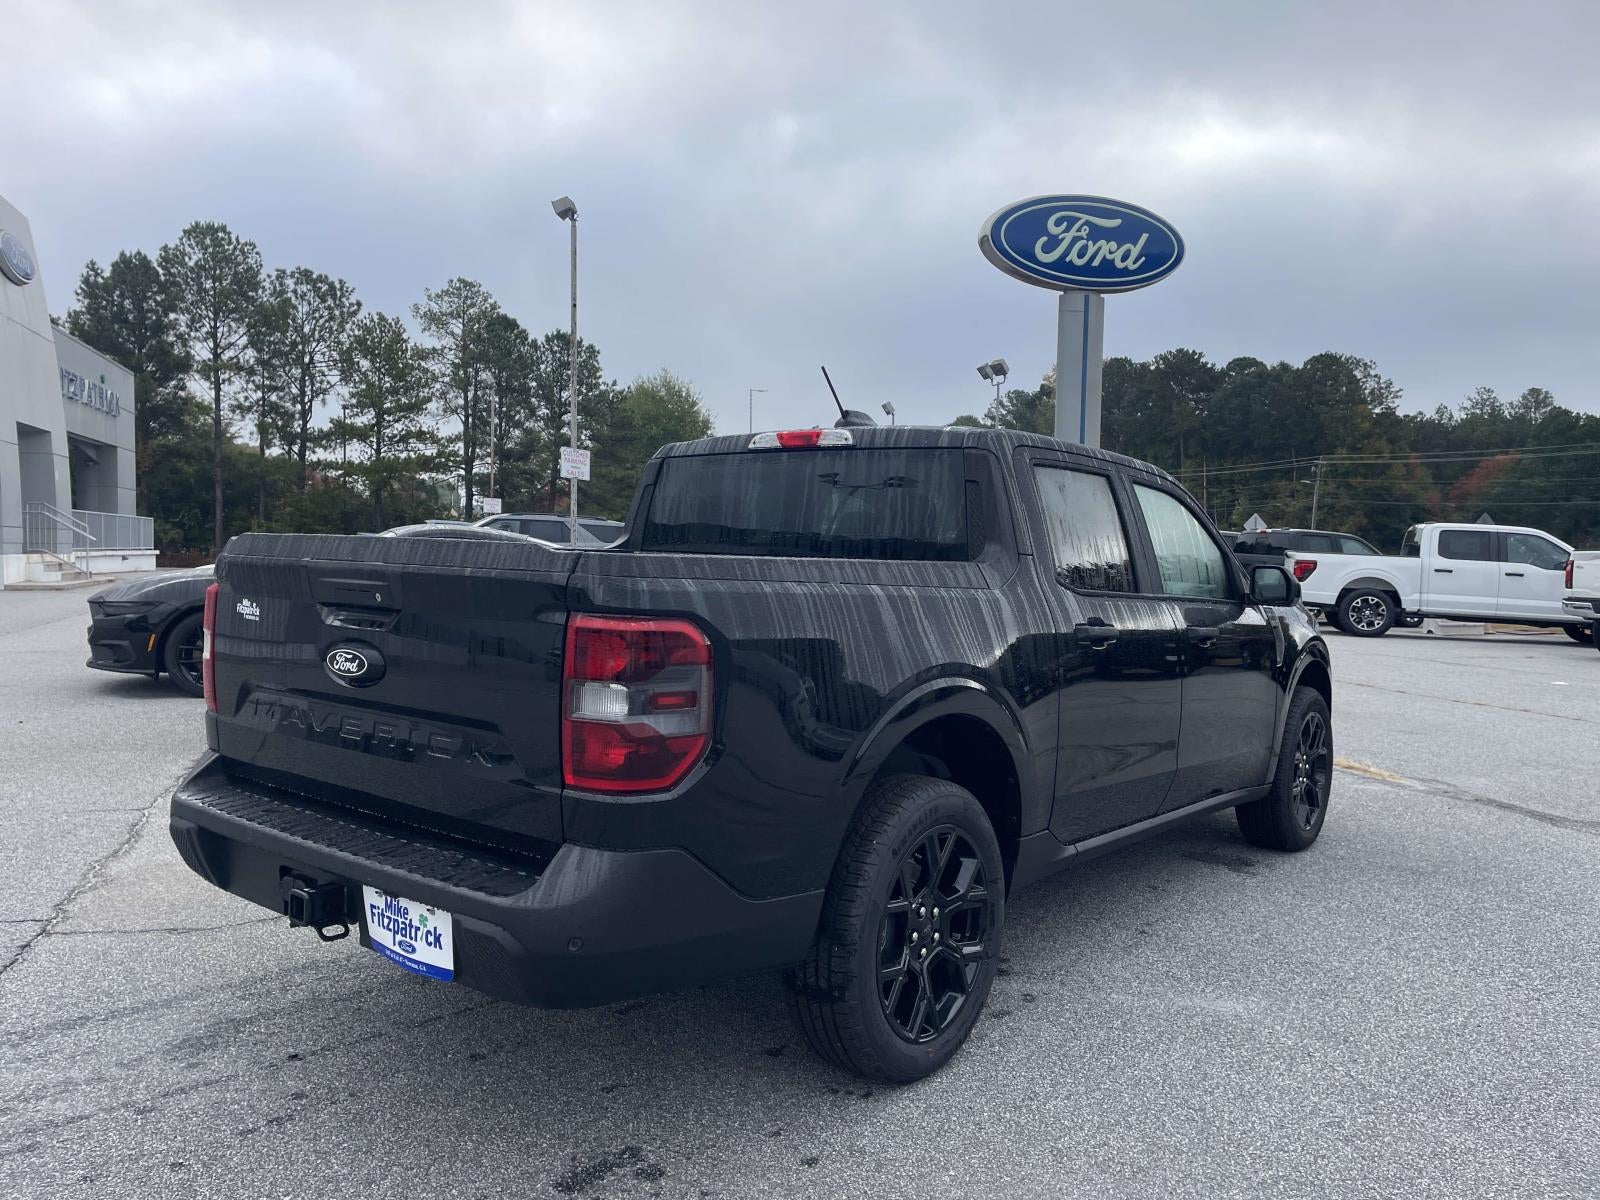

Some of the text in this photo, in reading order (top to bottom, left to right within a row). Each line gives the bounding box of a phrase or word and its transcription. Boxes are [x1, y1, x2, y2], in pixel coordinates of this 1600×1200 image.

[1034, 211, 1150, 271] Ford
[333, 652, 359, 672] Ford
[253, 698, 495, 767] MAVERICK
[369, 903, 443, 950] Fitzpatrick
[384, 896, 409, 921] Mike
